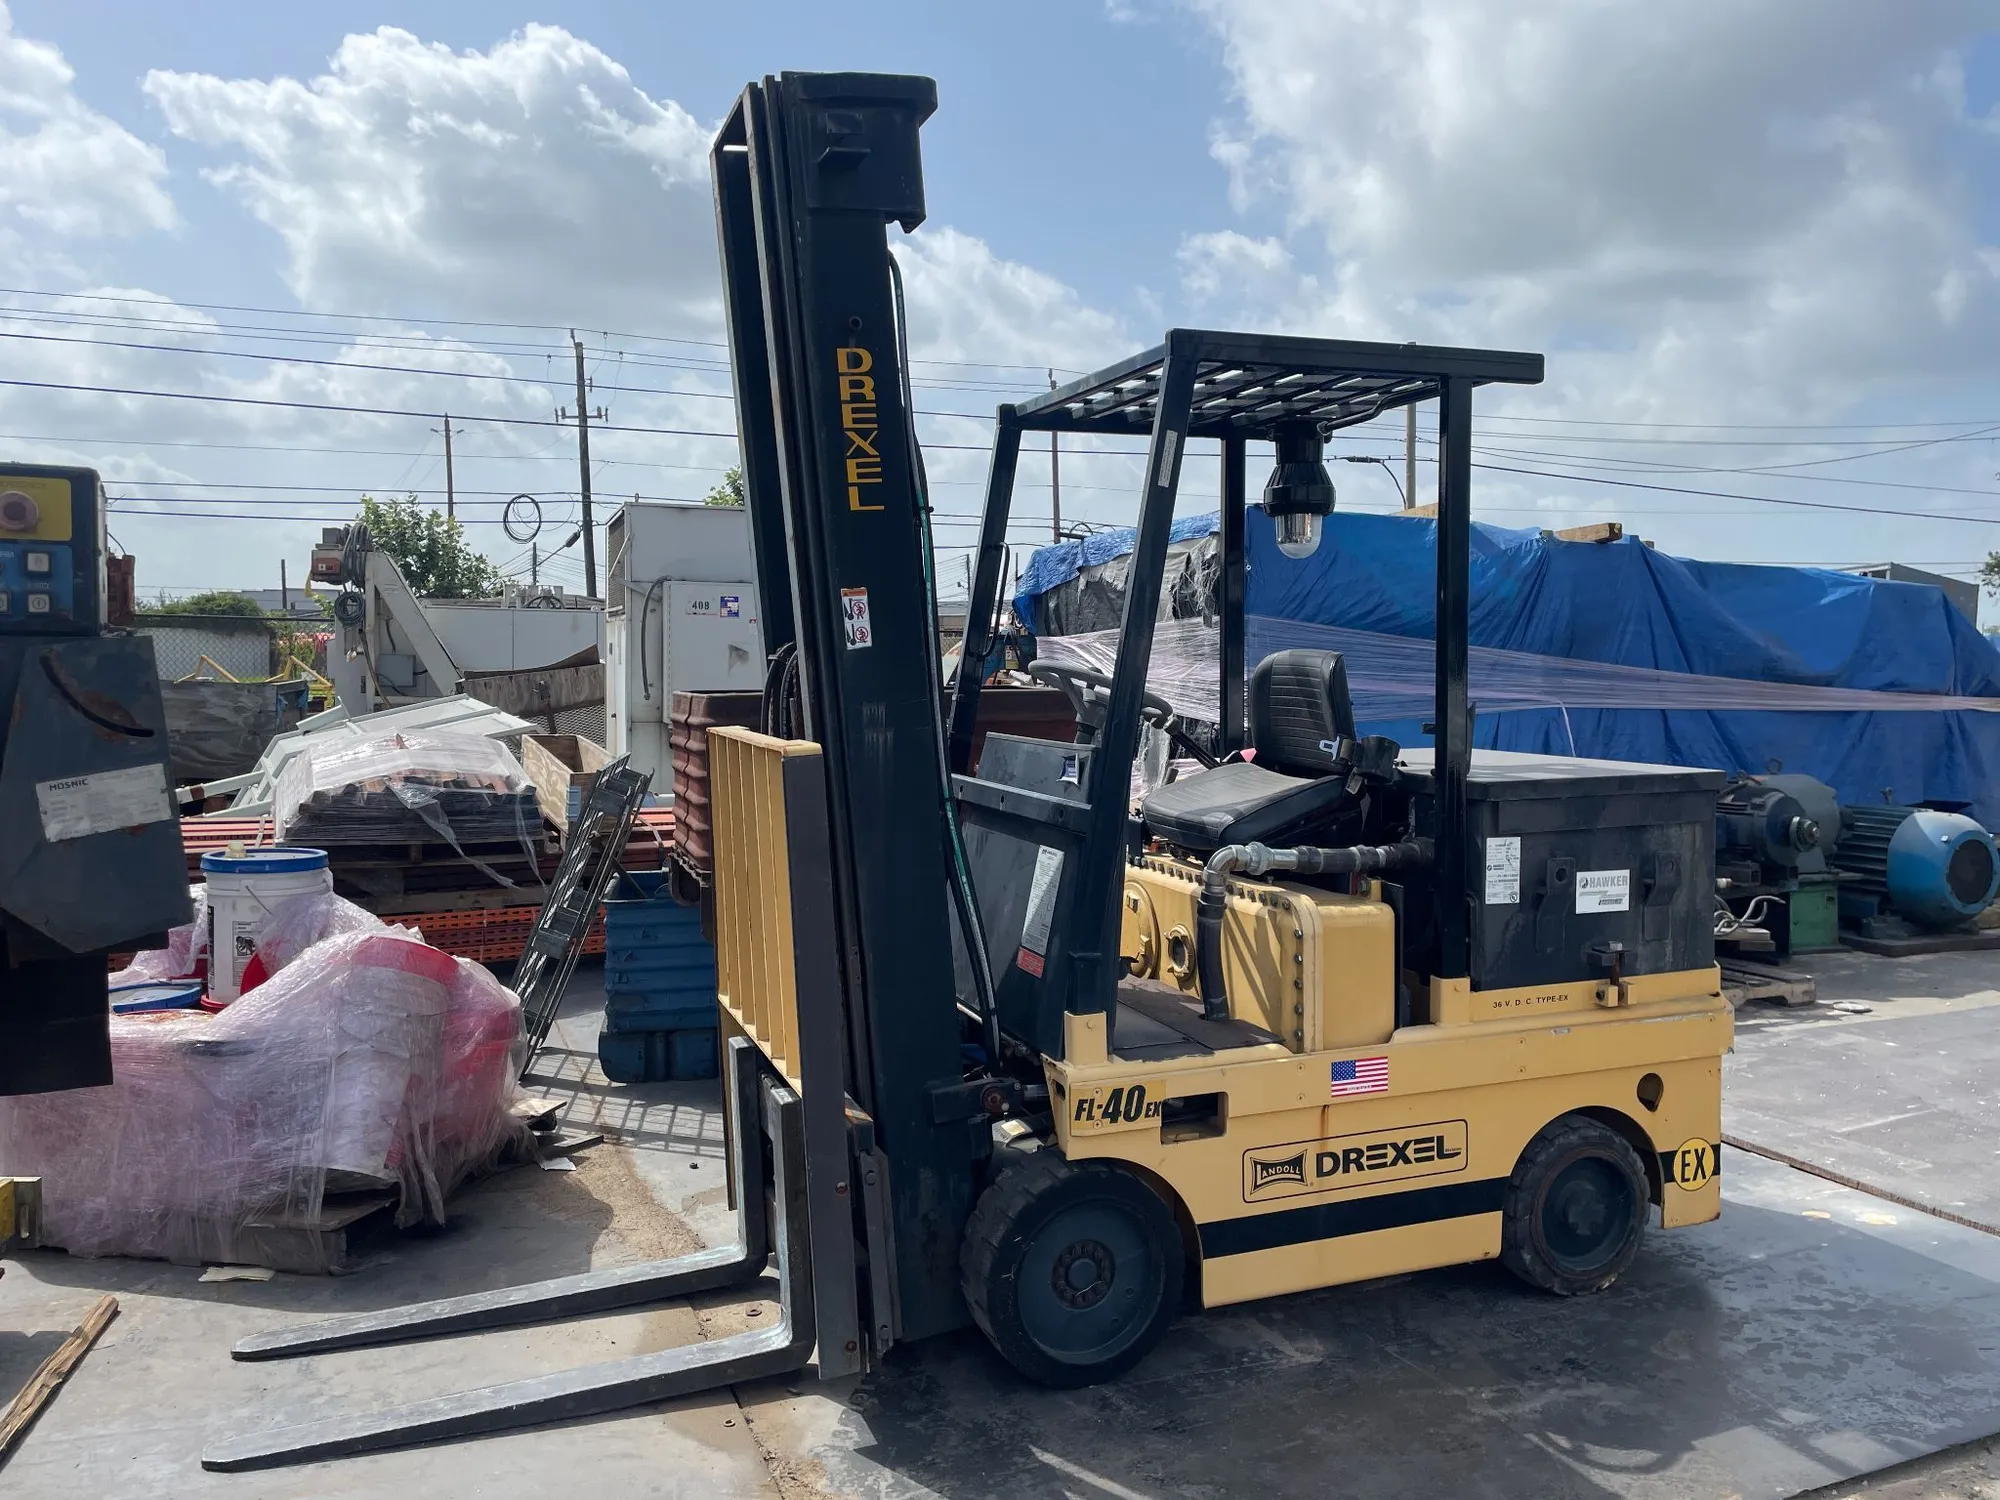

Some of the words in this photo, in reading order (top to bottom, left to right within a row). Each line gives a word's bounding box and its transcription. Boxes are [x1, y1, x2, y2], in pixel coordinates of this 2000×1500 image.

[836, 347, 885, 511] DREXEL
[49, 778, 89, 792] MOSNIC
[1589, 875, 1628, 889] HAWKER
[1493, 1001, 1502, 1009] 36
[1536, 994, 1568, 1003] TYPE-EX
[1256, 1164, 1301, 1186] LANDOLL
[1315, 1135, 1462, 1178] DREXEL
[1681, 1147, 1706, 1183] EX
